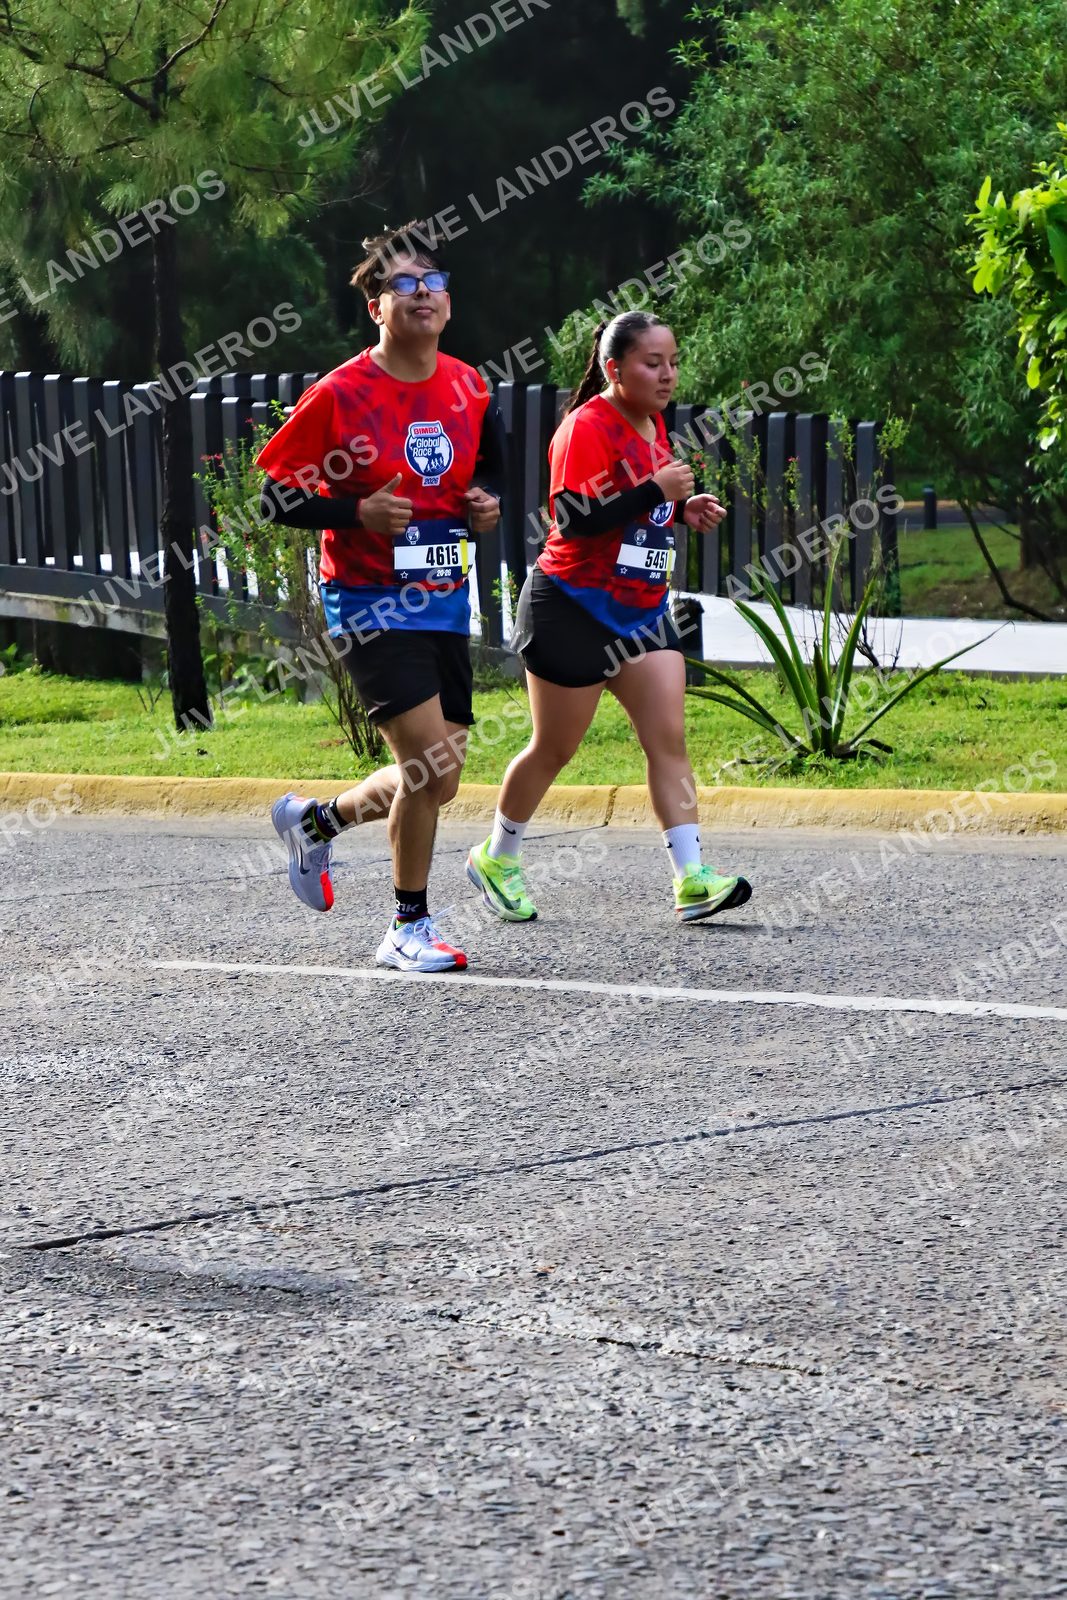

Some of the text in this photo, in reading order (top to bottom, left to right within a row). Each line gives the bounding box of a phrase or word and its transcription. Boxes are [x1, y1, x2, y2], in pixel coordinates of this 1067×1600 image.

[414, 427, 438, 435] BIMBO
[416, 437, 440, 448] Global
[413, 447, 432, 457] Race
[424, 477, 439, 485] 2026
[426, 545, 459, 566] 4615
[645, 550, 668, 569] 5451
